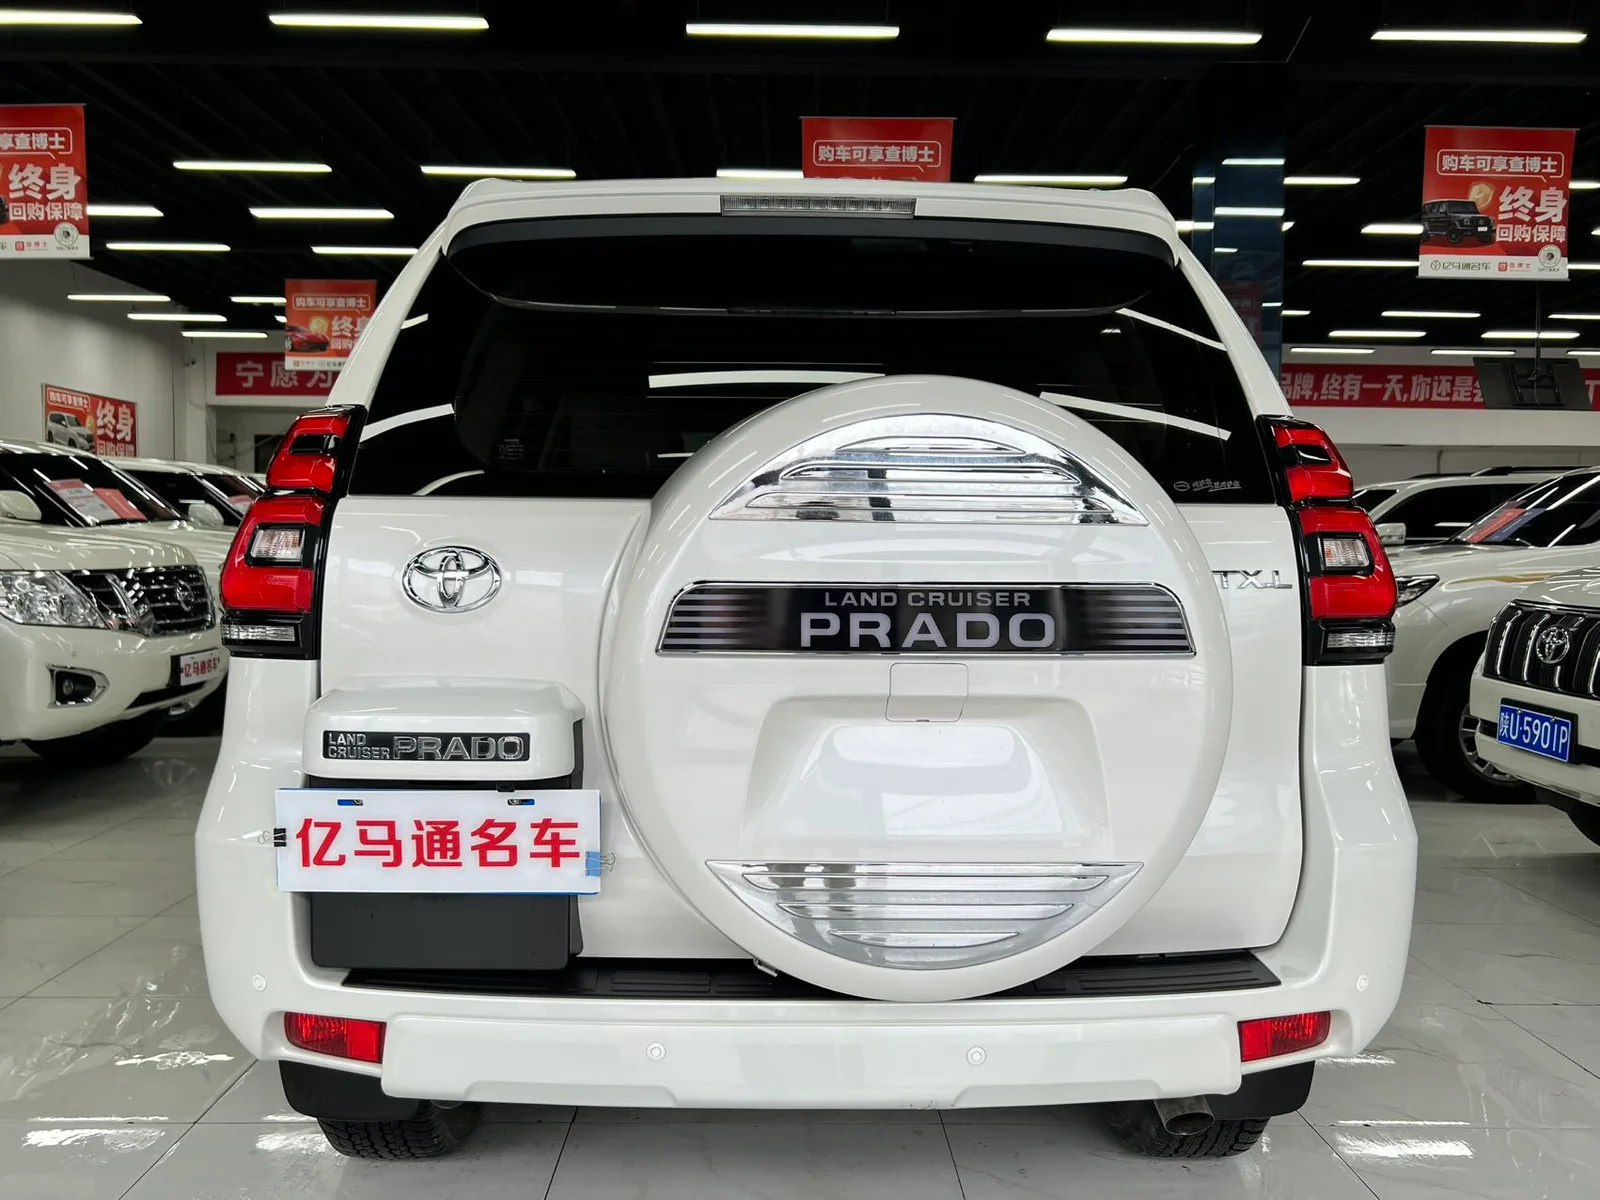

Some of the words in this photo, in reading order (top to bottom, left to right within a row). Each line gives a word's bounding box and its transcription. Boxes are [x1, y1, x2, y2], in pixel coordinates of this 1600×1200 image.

[818, 145, 935, 163] 购车可享查博士
[1442, 155, 1557, 173] 购车可享查博士
[8, 163, 82, 200] 终身
[8, 202, 83, 221] 回购保障
[1498, 186, 1568, 223] 终身
[1495, 224, 1566, 243] 回购保障
[295, 296, 366, 308] 购车可享查博士
[96, 400, 134, 442] 终身
[825, 592, 898, 607] LAND
[907, 592, 1031, 607] CRUISER
[800, 612, 1056, 648] PRADO
[328, 733, 367, 746] LAND
[393, 736, 525, 760] PRADO
[328, 746, 391, 760] CRUISER
[296, 818, 581, 868] 亿马通名车
